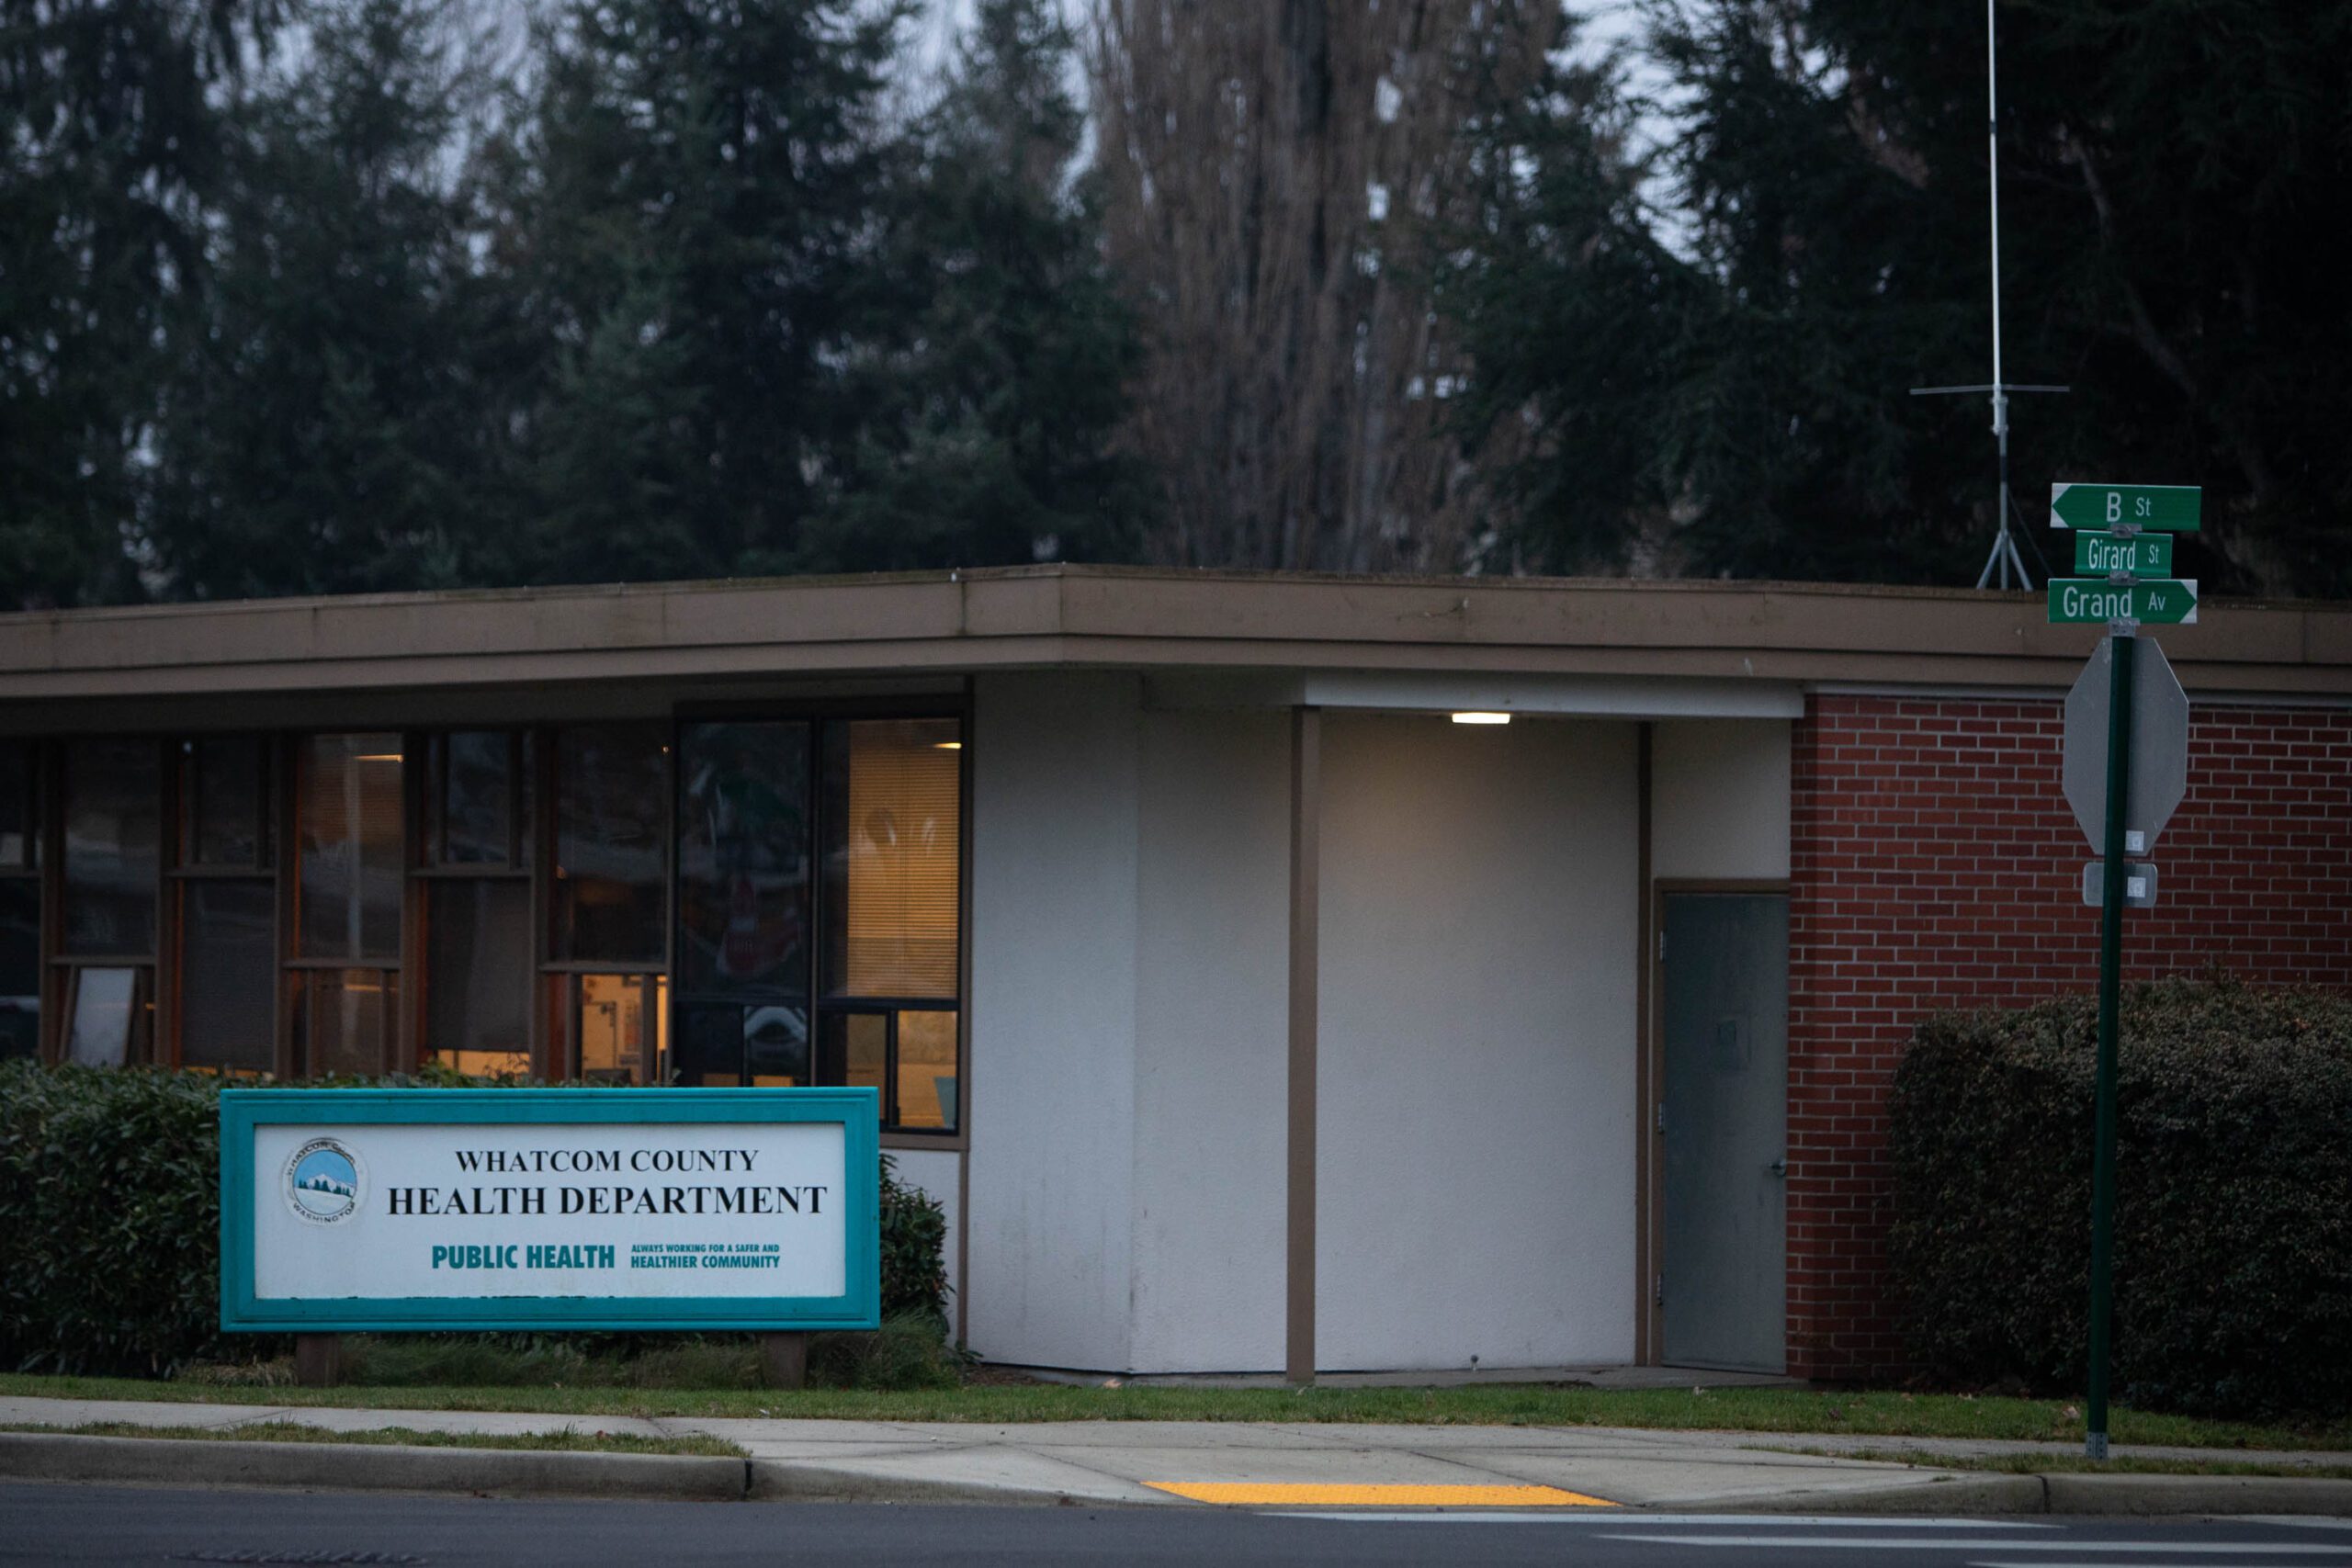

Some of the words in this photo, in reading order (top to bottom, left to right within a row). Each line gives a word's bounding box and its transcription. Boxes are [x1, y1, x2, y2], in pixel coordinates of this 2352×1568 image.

[2106, 491, 2121, 522] B
[2135, 497, 2151, 516] St
[2088, 538, 2136, 570] Girard
[2148, 544, 2159, 564] St
[2063, 586, 2132, 617] Grand
[2148, 592, 2165, 611] Av
[456, 1150, 622, 1172] WHATCOM
[630, 1149, 759, 1172] COUNTY
[387, 1187, 548, 1214] HEALTH
[558, 1186, 828, 1214] DEPARTMENT
[432, 1245, 518, 1269] PUBLIC
[526, 1245, 615, 1269] HEALTH
[631, 1244, 663, 1253] ALWAYS
[666, 1244, 707, 1253] WORKING
[708, 1244, 725, 1253] FOR
[727, 1244, 732, 1253] A
[735, 1244, 760, 1253] SAFER
[762, 1244, 780, 1253] AND
[630, 1255, 697, 1269] HEALTHIER
[701, 1255, 780, 1269] COMMUNITY
